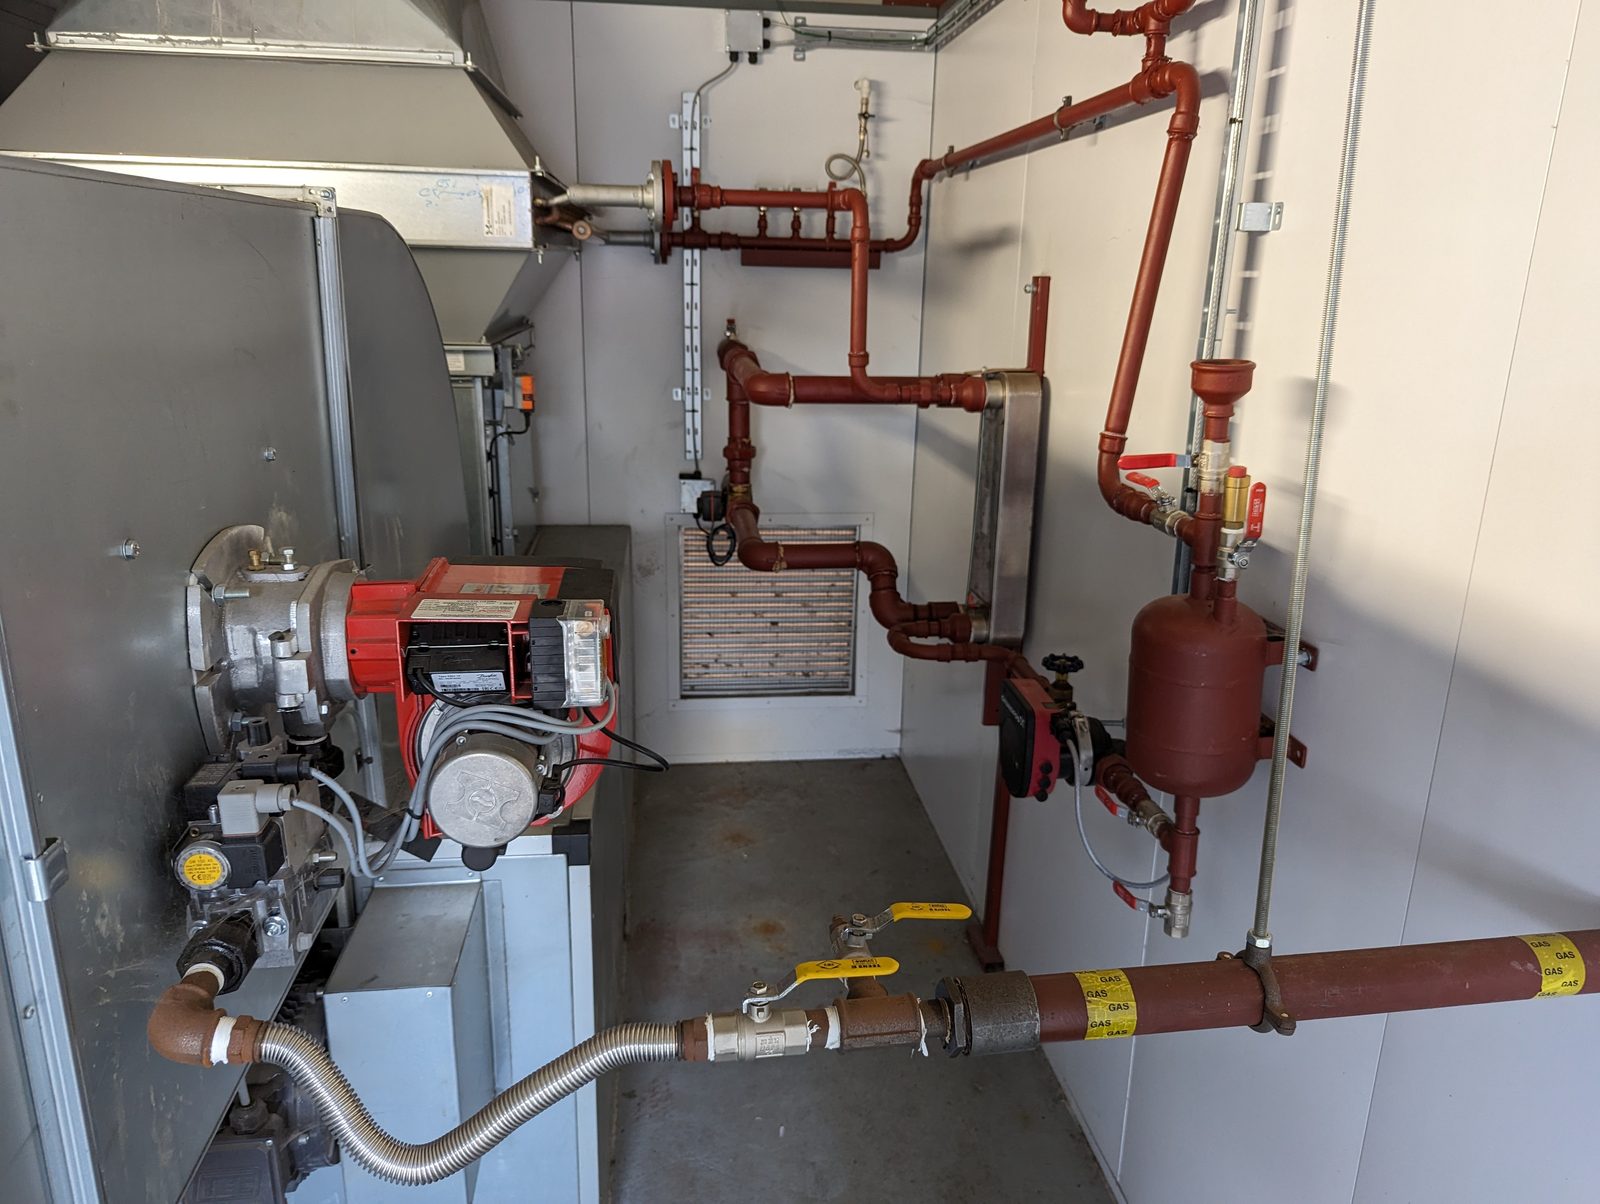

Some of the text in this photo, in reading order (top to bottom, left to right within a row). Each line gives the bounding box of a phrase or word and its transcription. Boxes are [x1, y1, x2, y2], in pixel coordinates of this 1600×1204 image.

[1556, 951, 1575, 960] GAS
[1544, 967, 1563, 976] GAS
[1087, 990, 1108, 998] GAS
[1108, 1003, 1130, 1012] GAS
[1090, 1019, 1111, 1028] GAS
